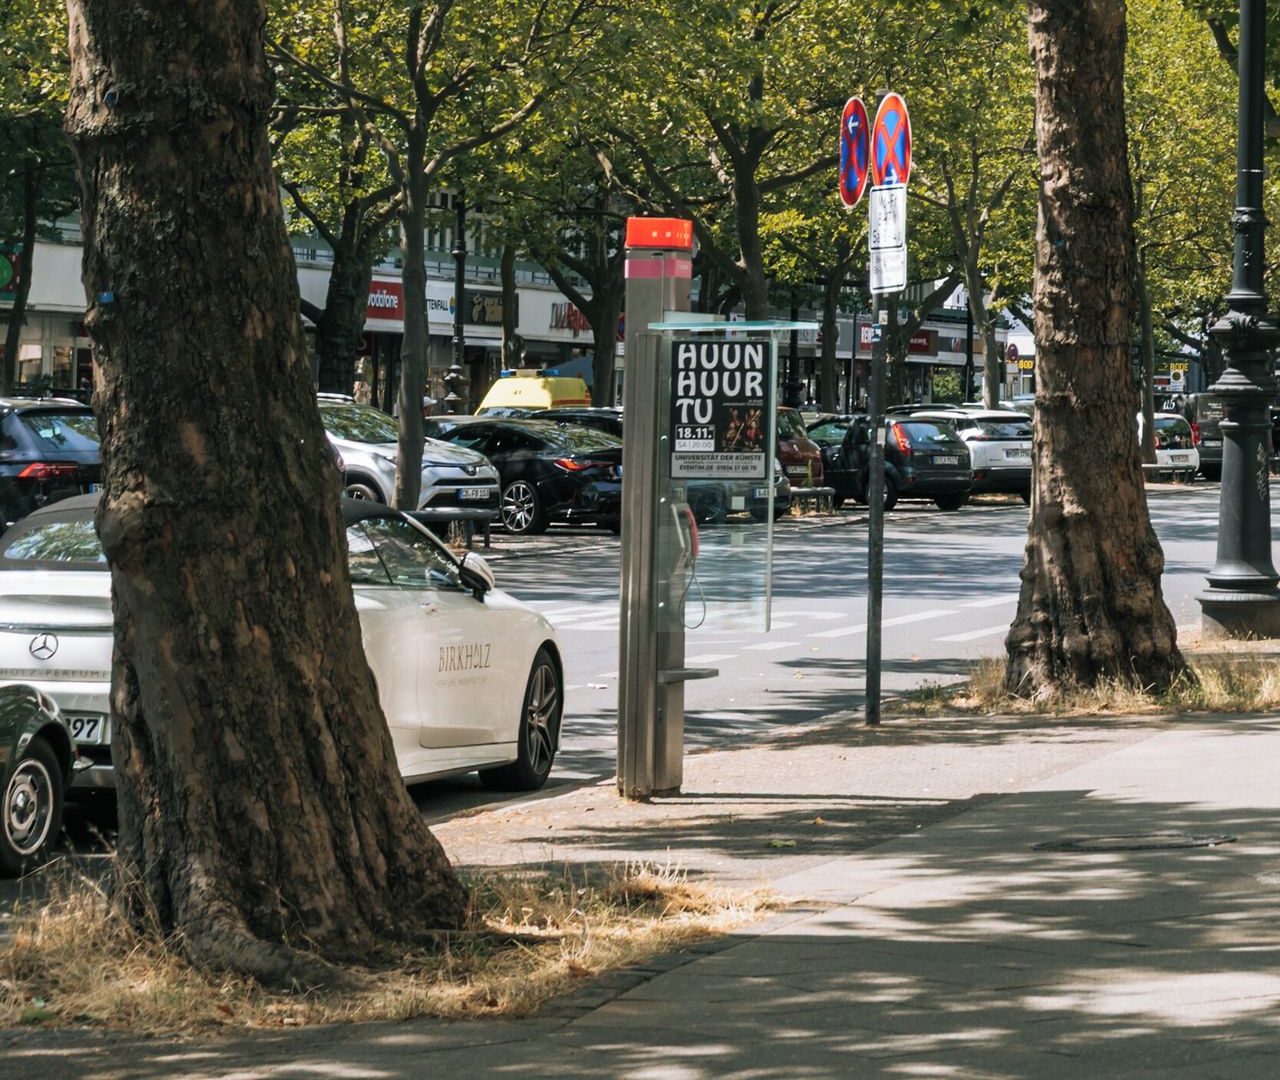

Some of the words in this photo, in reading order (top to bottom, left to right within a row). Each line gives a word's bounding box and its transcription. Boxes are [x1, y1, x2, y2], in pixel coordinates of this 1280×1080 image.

[678, 344, 763, 369] HUUN
[677, 371, 763, 397] HUUR
[675, 398, 713, 424] TU
[677, 427, 712, 439] 18.11.
[64, 718, 99, 739] 97
